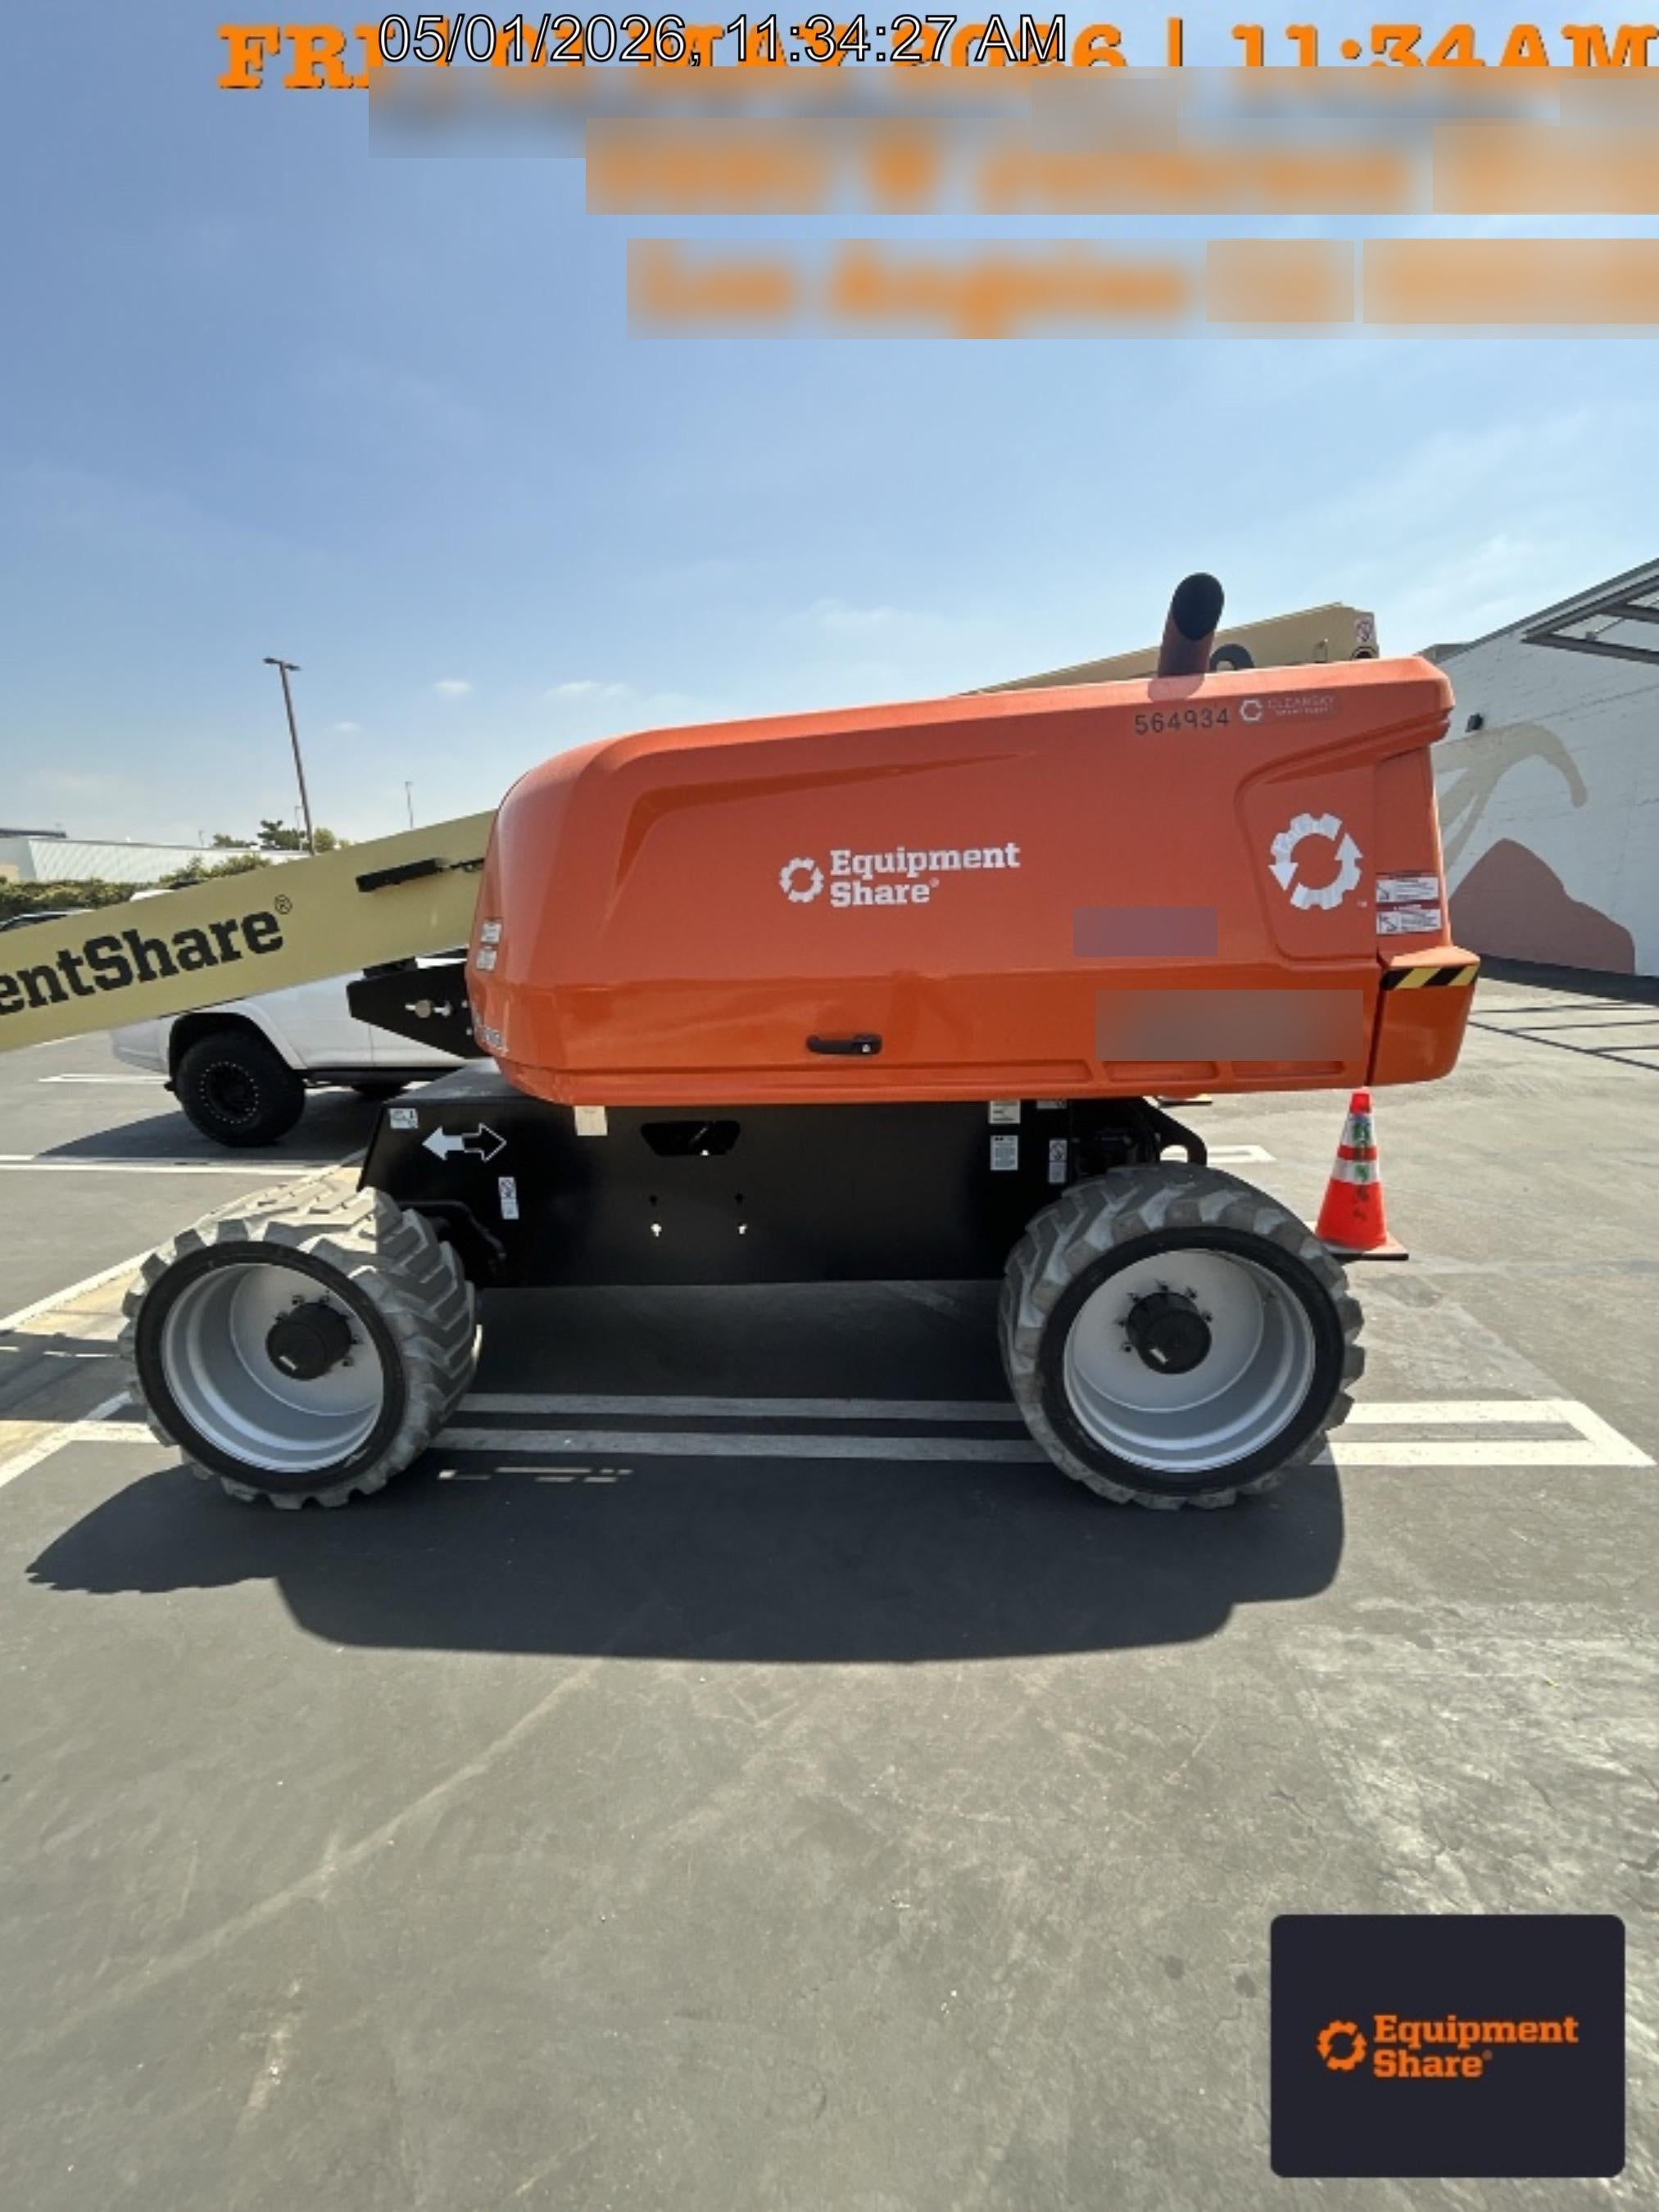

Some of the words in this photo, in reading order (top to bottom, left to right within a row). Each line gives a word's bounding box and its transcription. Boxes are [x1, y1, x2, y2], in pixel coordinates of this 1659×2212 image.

[1134, 707, 1229, 736] 564934
[830, 842, 1021, 880] Equipment
[830, 880, 931, 907] Share
